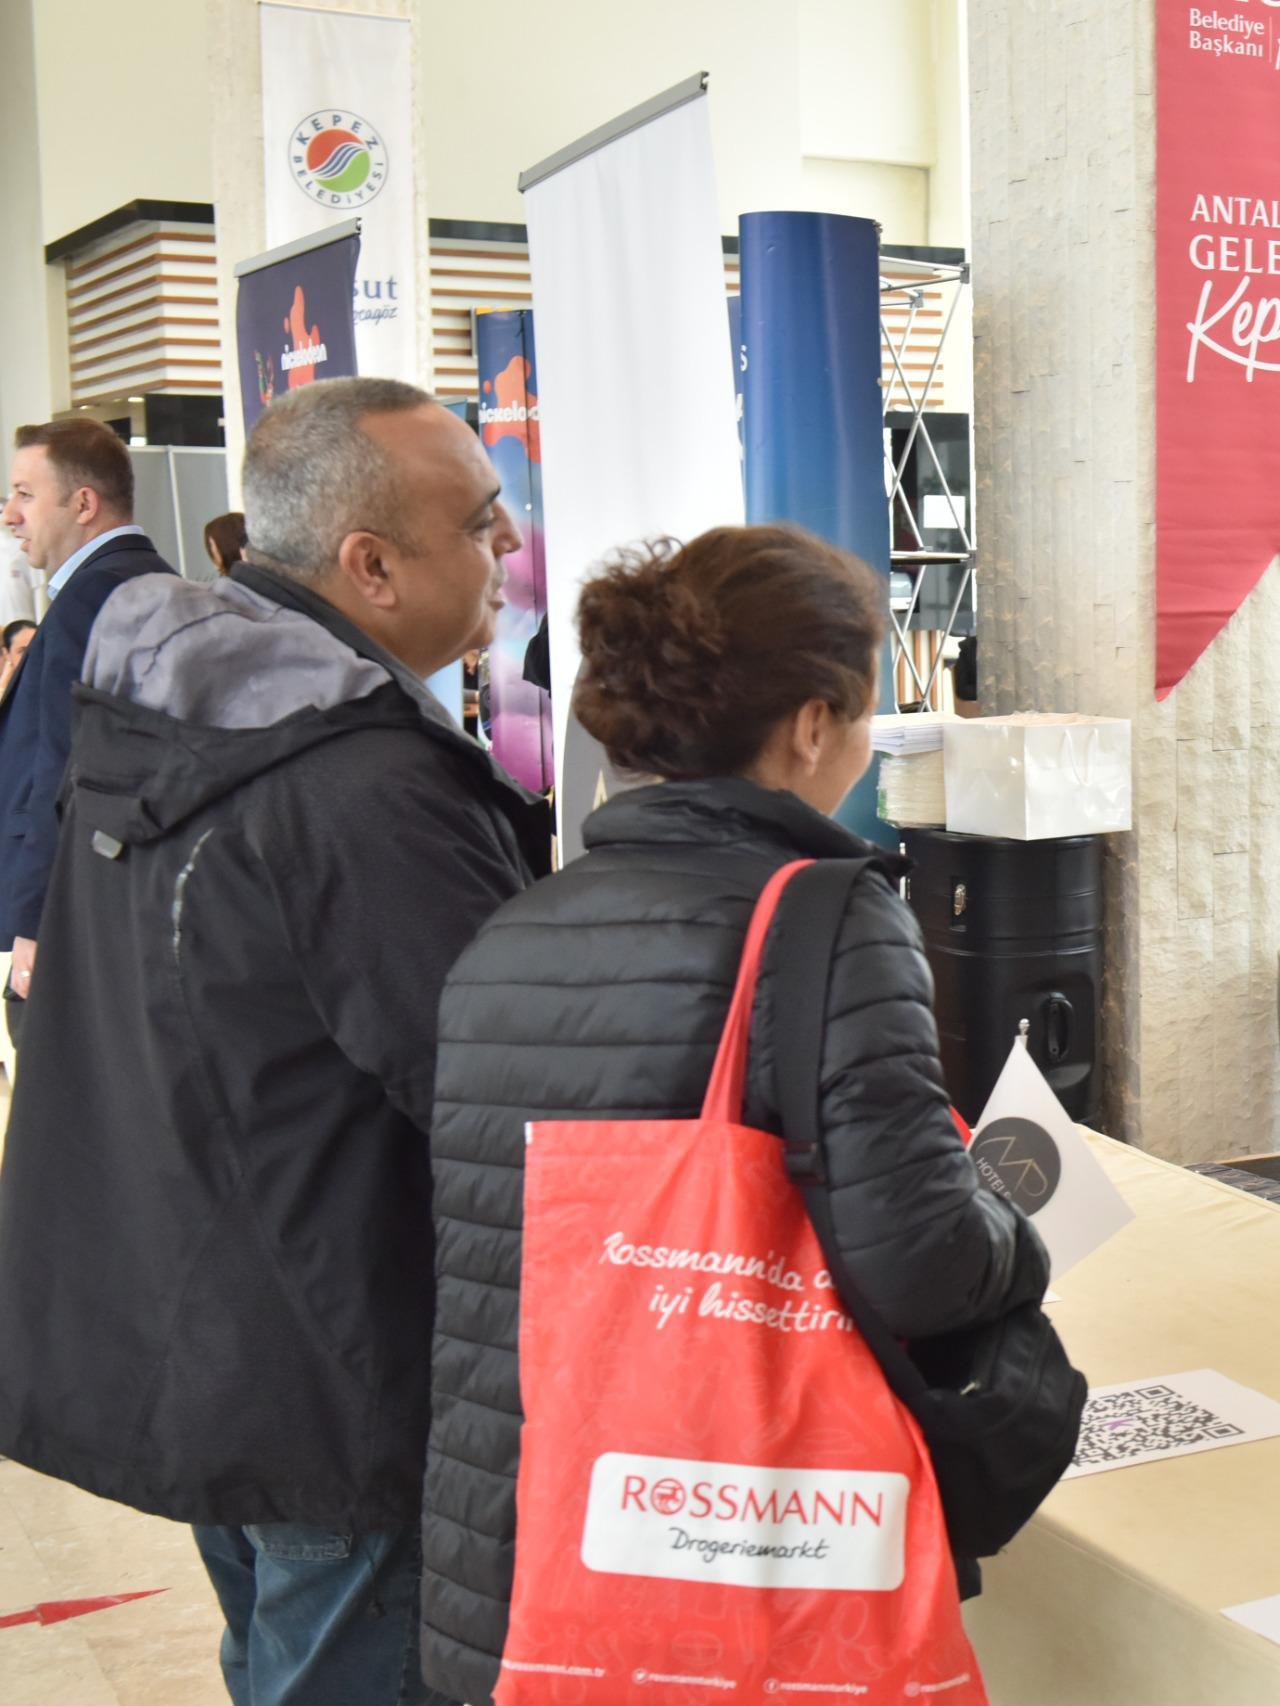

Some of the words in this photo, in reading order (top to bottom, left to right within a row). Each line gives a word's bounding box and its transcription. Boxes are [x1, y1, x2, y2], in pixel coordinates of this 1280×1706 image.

[1190, 8, 1264, 39] Belediye
[1190, 31, 1263, 57] Başkanı
[296, 114, 379, 150] KEPEZ
[599, 1231, 805, 1291] Rossmann'da
[649, 1284, 694, 1330] iyi
[621, 1475, 883, 1527] ROSSMANN
[668, 1527, 829, 1563] Drogeriemarkt
